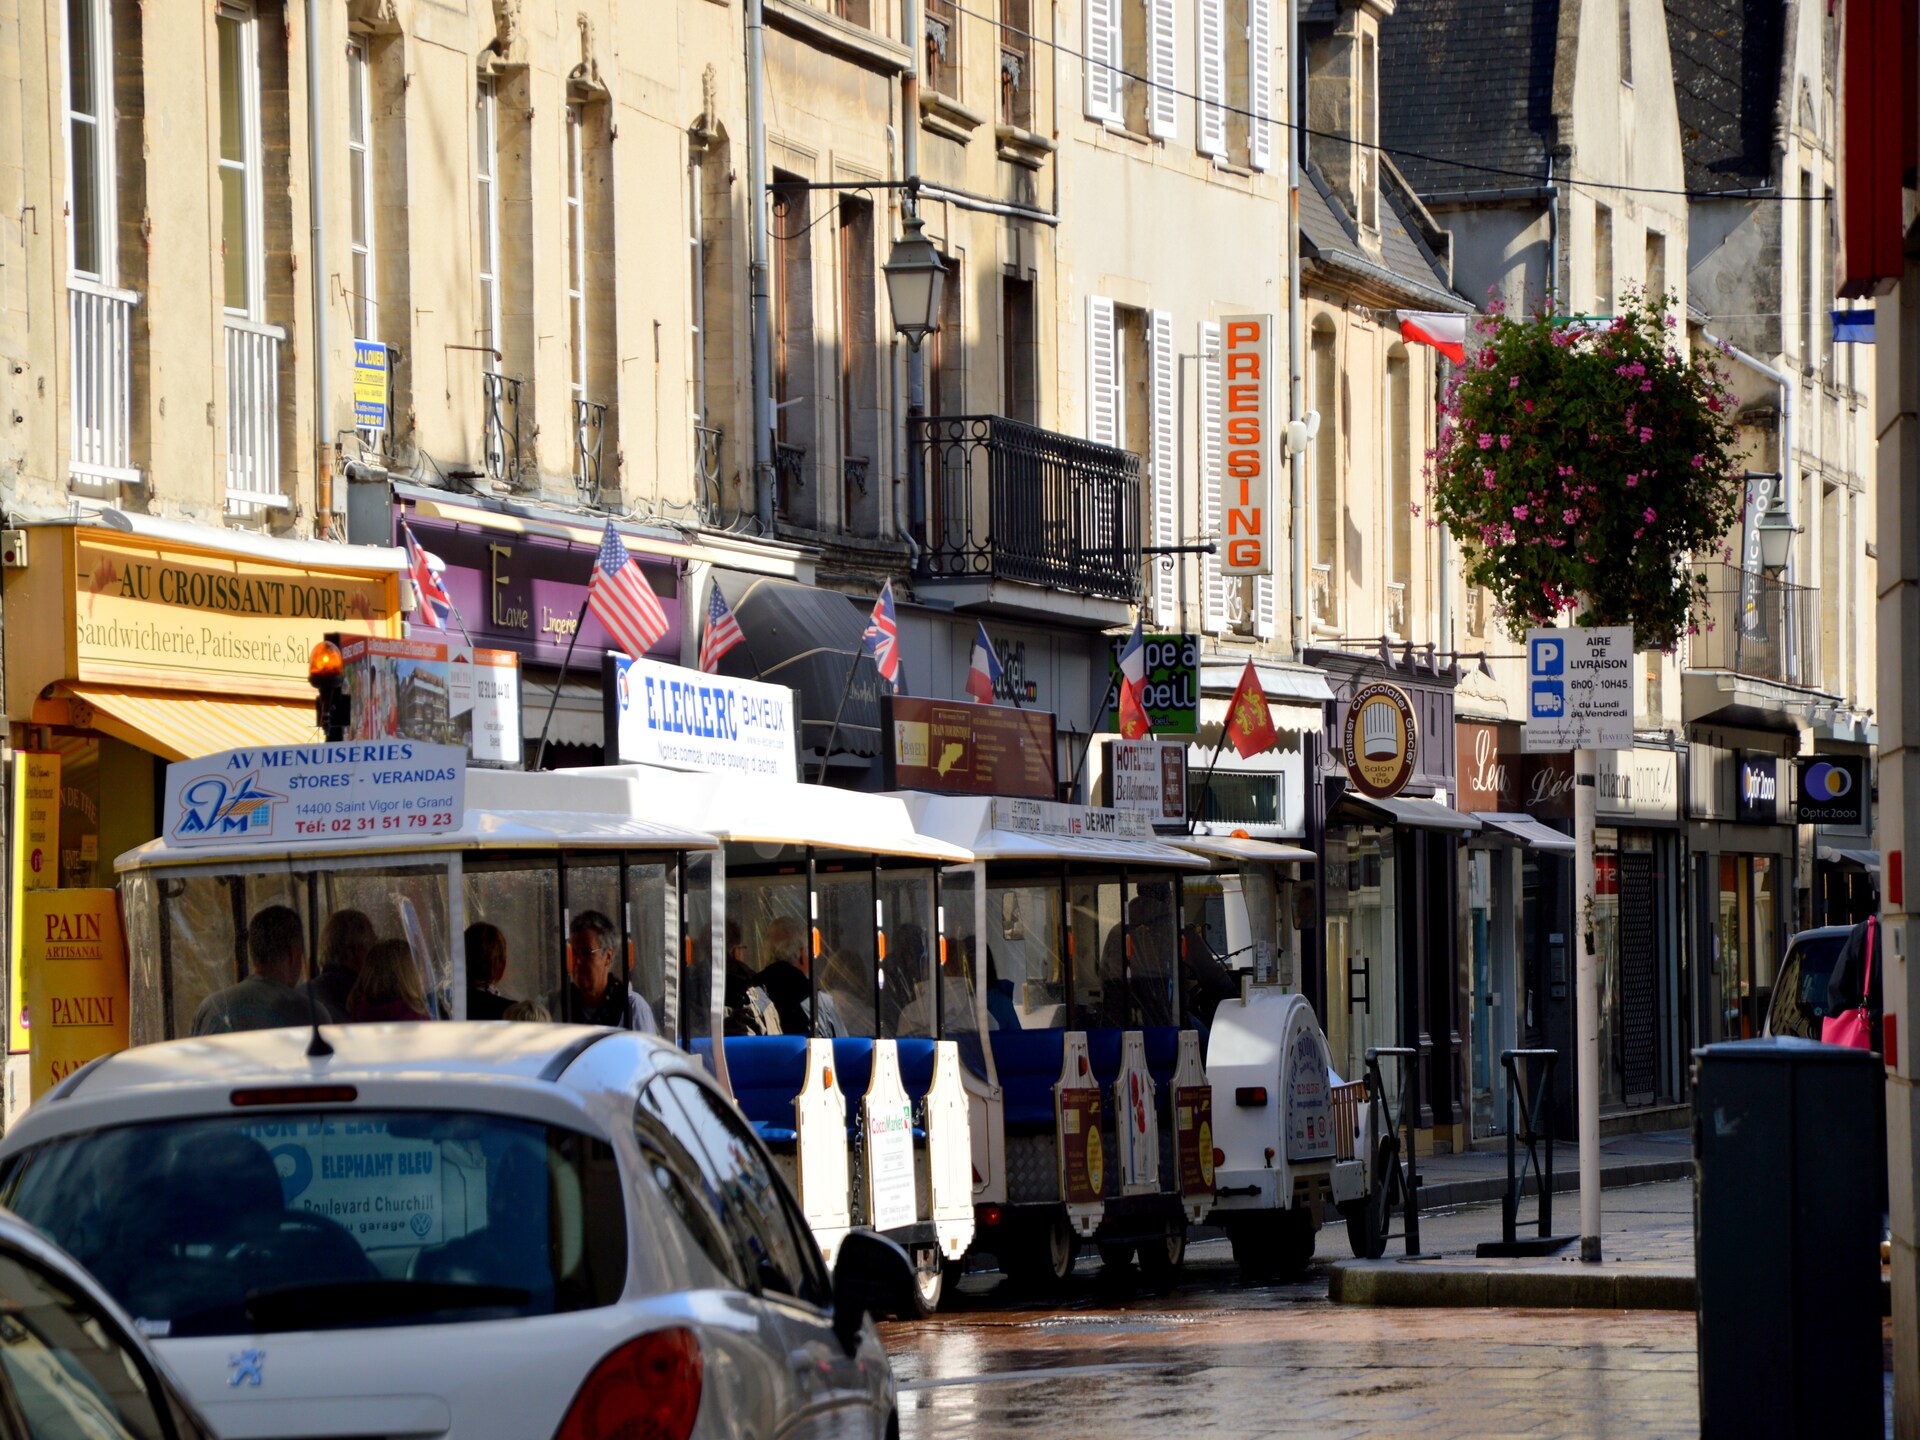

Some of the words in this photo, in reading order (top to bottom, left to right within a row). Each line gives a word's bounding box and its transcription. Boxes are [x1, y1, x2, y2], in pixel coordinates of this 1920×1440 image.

[358, 348, 363, 363] A
[364, 349, 384, 366] LOUER
[1228, 322, 1261, 567] PRESSING
[120, 562, 152, 599] AU
[160, 567, 284, 616] CROISSANT
[290, 584, 346, 622] DORE
[542, 606, 578, 644] Lingerie
[286, 635, 311, 664] Sal
[1586, 637, 1611, 646] AIRE
[1592, 648, 1606, 658] DE
[1112, 639, 1176, 675] tpe
[1182, 634, 1196, 667] à
[1570, 660, 1628, 669] LIVRAISON
[1571, 680, 1593, 689] 6h00
[1600, 680, 1628, 689] 10H45
[1352, 684, 1407, 712] Chocolatier
[1594, 700, 1619, 708] Lundi
[742, 695, 785, 732] BAYEUX
[658, 740, 678, 761] Notre
[706, 750, 726, 766] votre
[1405, 717, 1414, 765] Glacier
[226, 752, 256, 770] AV
[261, 744, 413, 768] MENUISERIES
[1116, 746, 1141, 771] HOTEL
[1472, 729, 1506, 792] Léa
[289, 773, 350, 790] STORES
[372, 768, 456, 785] VERANDAS
[1599, 763, 1632, 799] trianon
[296, 802, 332, 816] 14400
[336, 800, 365, 813] Saint
[368, 799, 399, 814] Vigor
[403, 798, 412, 810] le
[416, 796, 453, 808] Grand
[1800, 808, 1830, 820] Optic
[1831, 808, 1857, 818] 2000
[296, 818, 326, 834] Tél:
[331, 819, 351, 832] 02
[356, 817, 376, 830] 31
[382, 816, 400, 829] 51
[408, 814, 428, 828] 79
[432, 812, 452, 826] 23
[1012, 816, 1040, 831] TOURISTIQUE
[1085, 812, 1115, 833] DEPART
[45, 913, 102, 940] PAIN
[46, 946, 103, 958] ARTISANAL
[51, 996, 114, 1026] PANINI
[322, 1152, 394, 1180] ELEPHANT
[398, 1152, 432, 1175] BLEU
[374, 1196, 434, 1213] Churchill
[360, 1221, 406, 1234] garage
